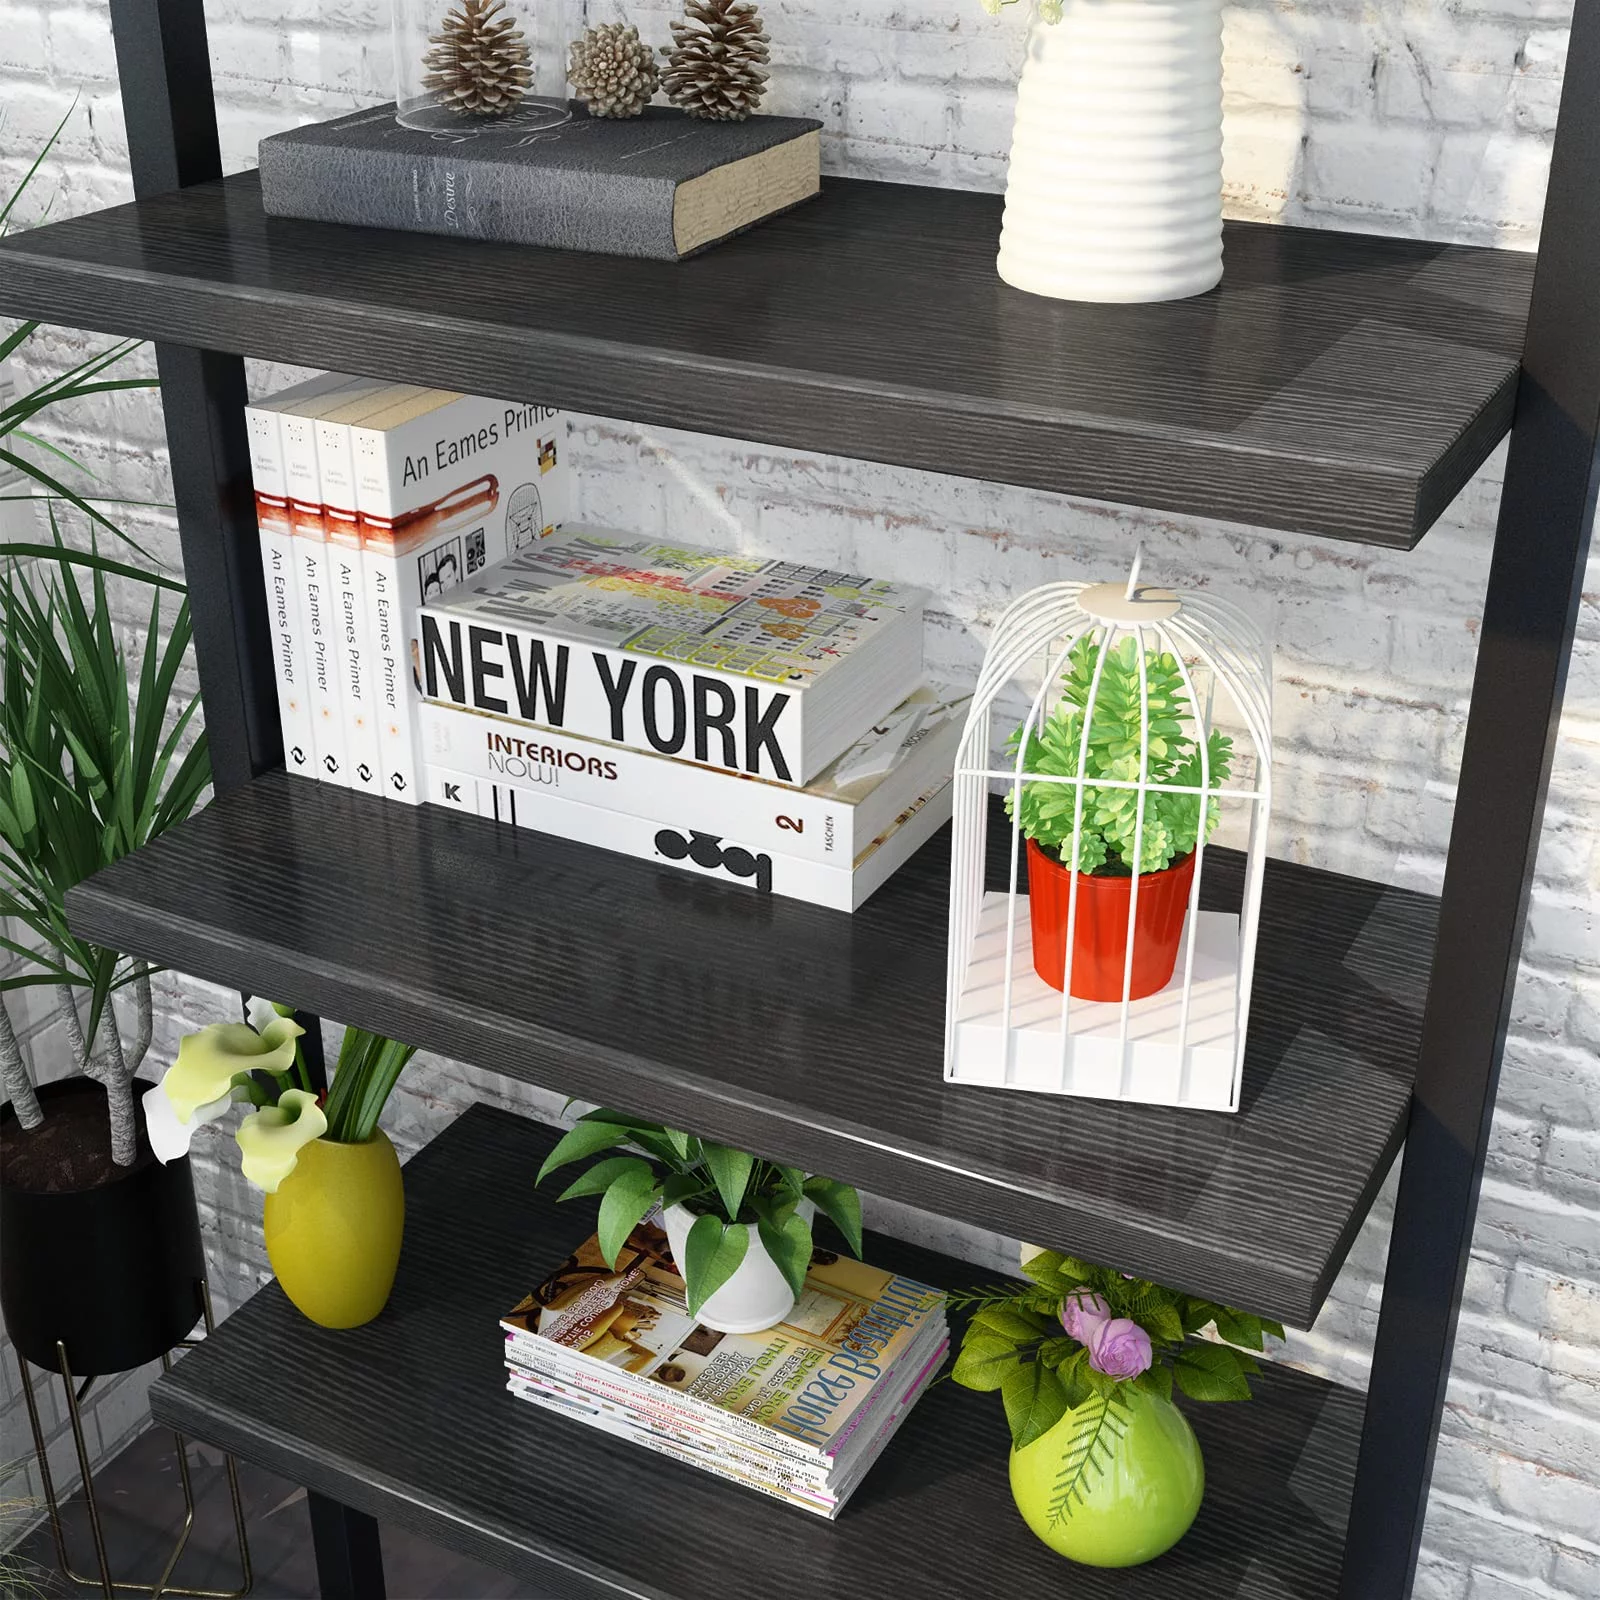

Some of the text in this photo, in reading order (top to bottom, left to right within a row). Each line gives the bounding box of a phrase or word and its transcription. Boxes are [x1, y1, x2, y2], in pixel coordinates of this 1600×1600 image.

[403, 456, 428, 487] An
[436, 423, 498, 470] Eames
[272, 548, 294, 684] An Eames Primer
[305, 556, 328, 692] An Eames Primer
[340, 563, 362, 700] An Eames Primer
[376, 571, 396, 709] An Eames Primer
[421, 614, 793, 783] NEW YORK
[487, 732, 618, 780] INTERIORS
[488, 752, 558, 787] NOW!
[776, 815, 803, 834] 2
[824, 816, 834, 852] TASCHEN
